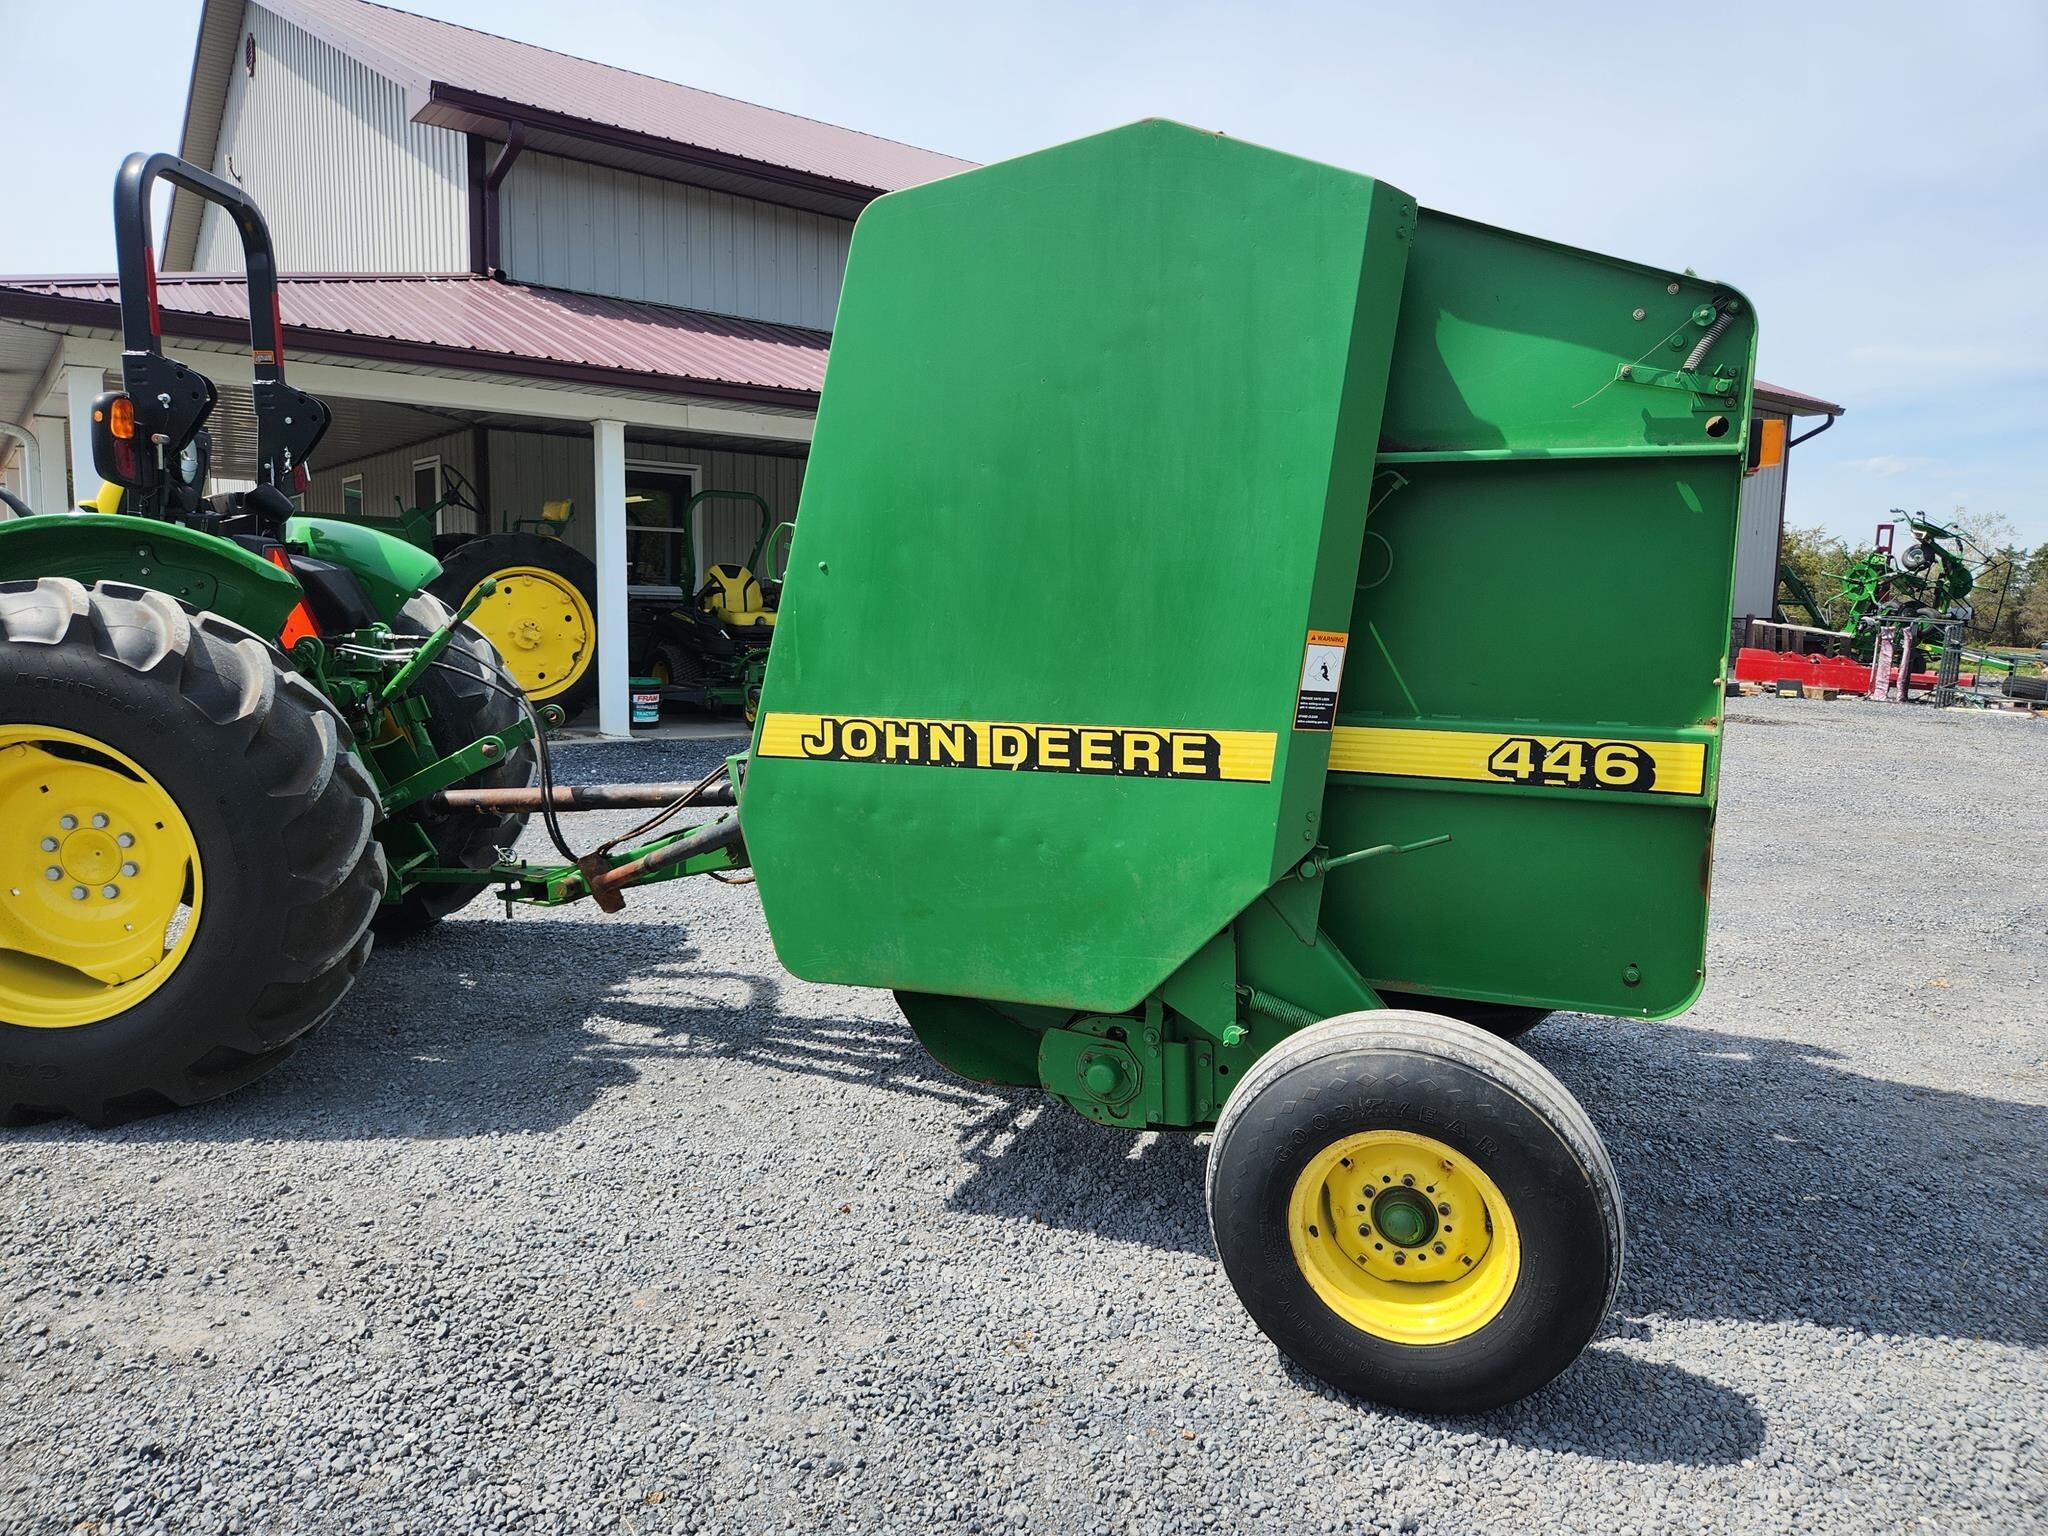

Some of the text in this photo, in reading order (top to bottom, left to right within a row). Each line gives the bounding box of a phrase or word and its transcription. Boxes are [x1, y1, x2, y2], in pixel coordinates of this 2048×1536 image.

[1317, 635, 1344, 643] WARNING
[802, 718, 1215, 775] JOHN DEERE
[1490, 738, 1646, 788] 446
[1274, 1099, 1500, 1162] GOODYEAR
